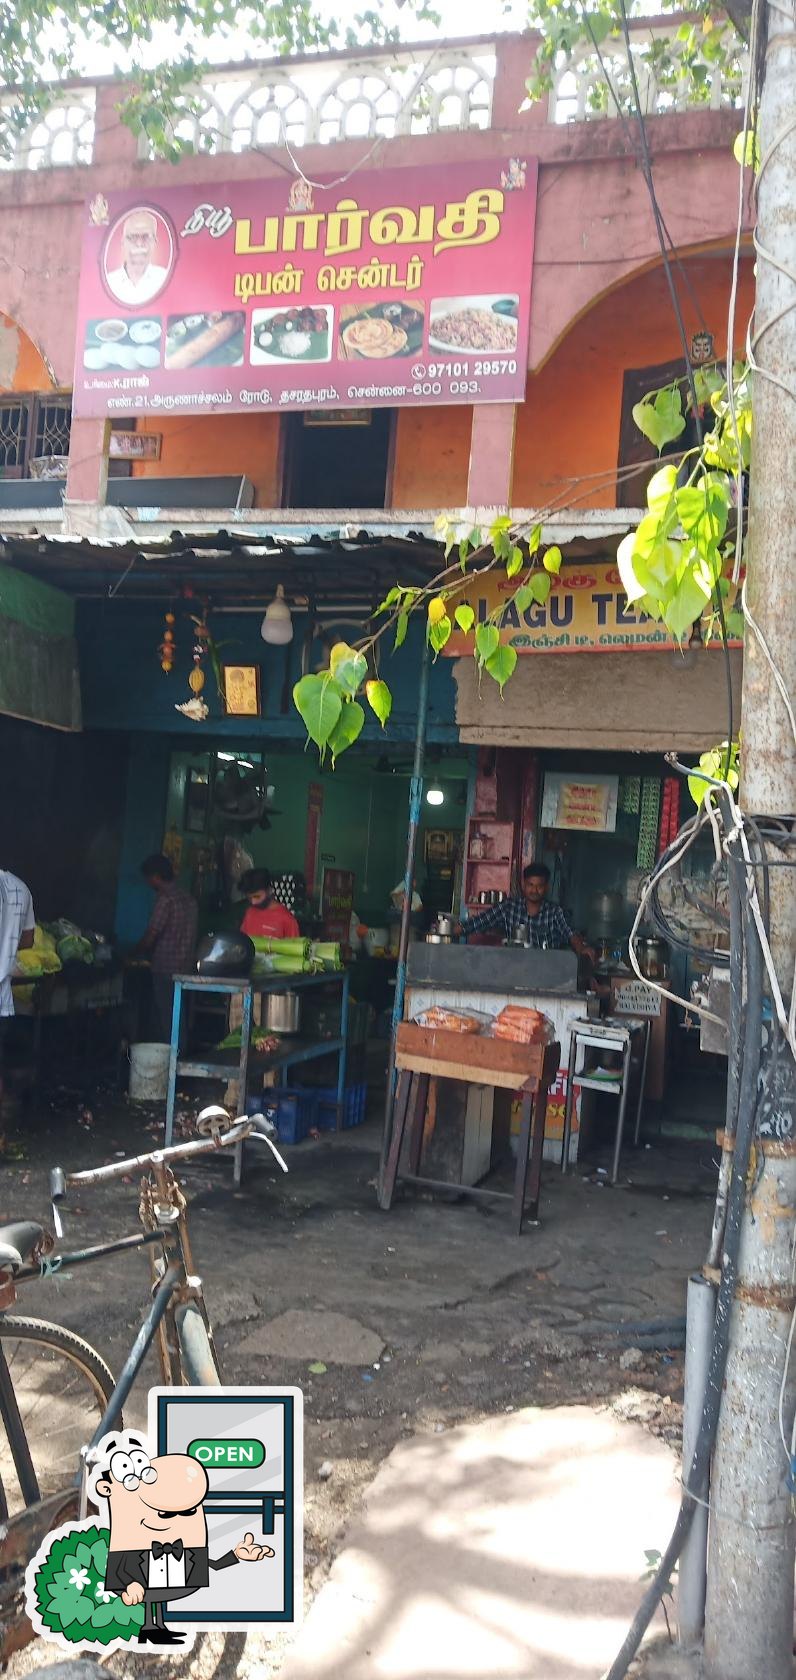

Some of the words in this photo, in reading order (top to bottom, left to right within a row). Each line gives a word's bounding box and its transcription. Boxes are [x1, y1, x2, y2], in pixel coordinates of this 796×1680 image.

[233, 187, 505, 256] பார்வதி
[233, 262, 304, 303] டிபன்
[316, 254, 424, 292] சென்டர்
[428, 361, 469, 377] 97101
[474, 359, 517, 375] 29570
